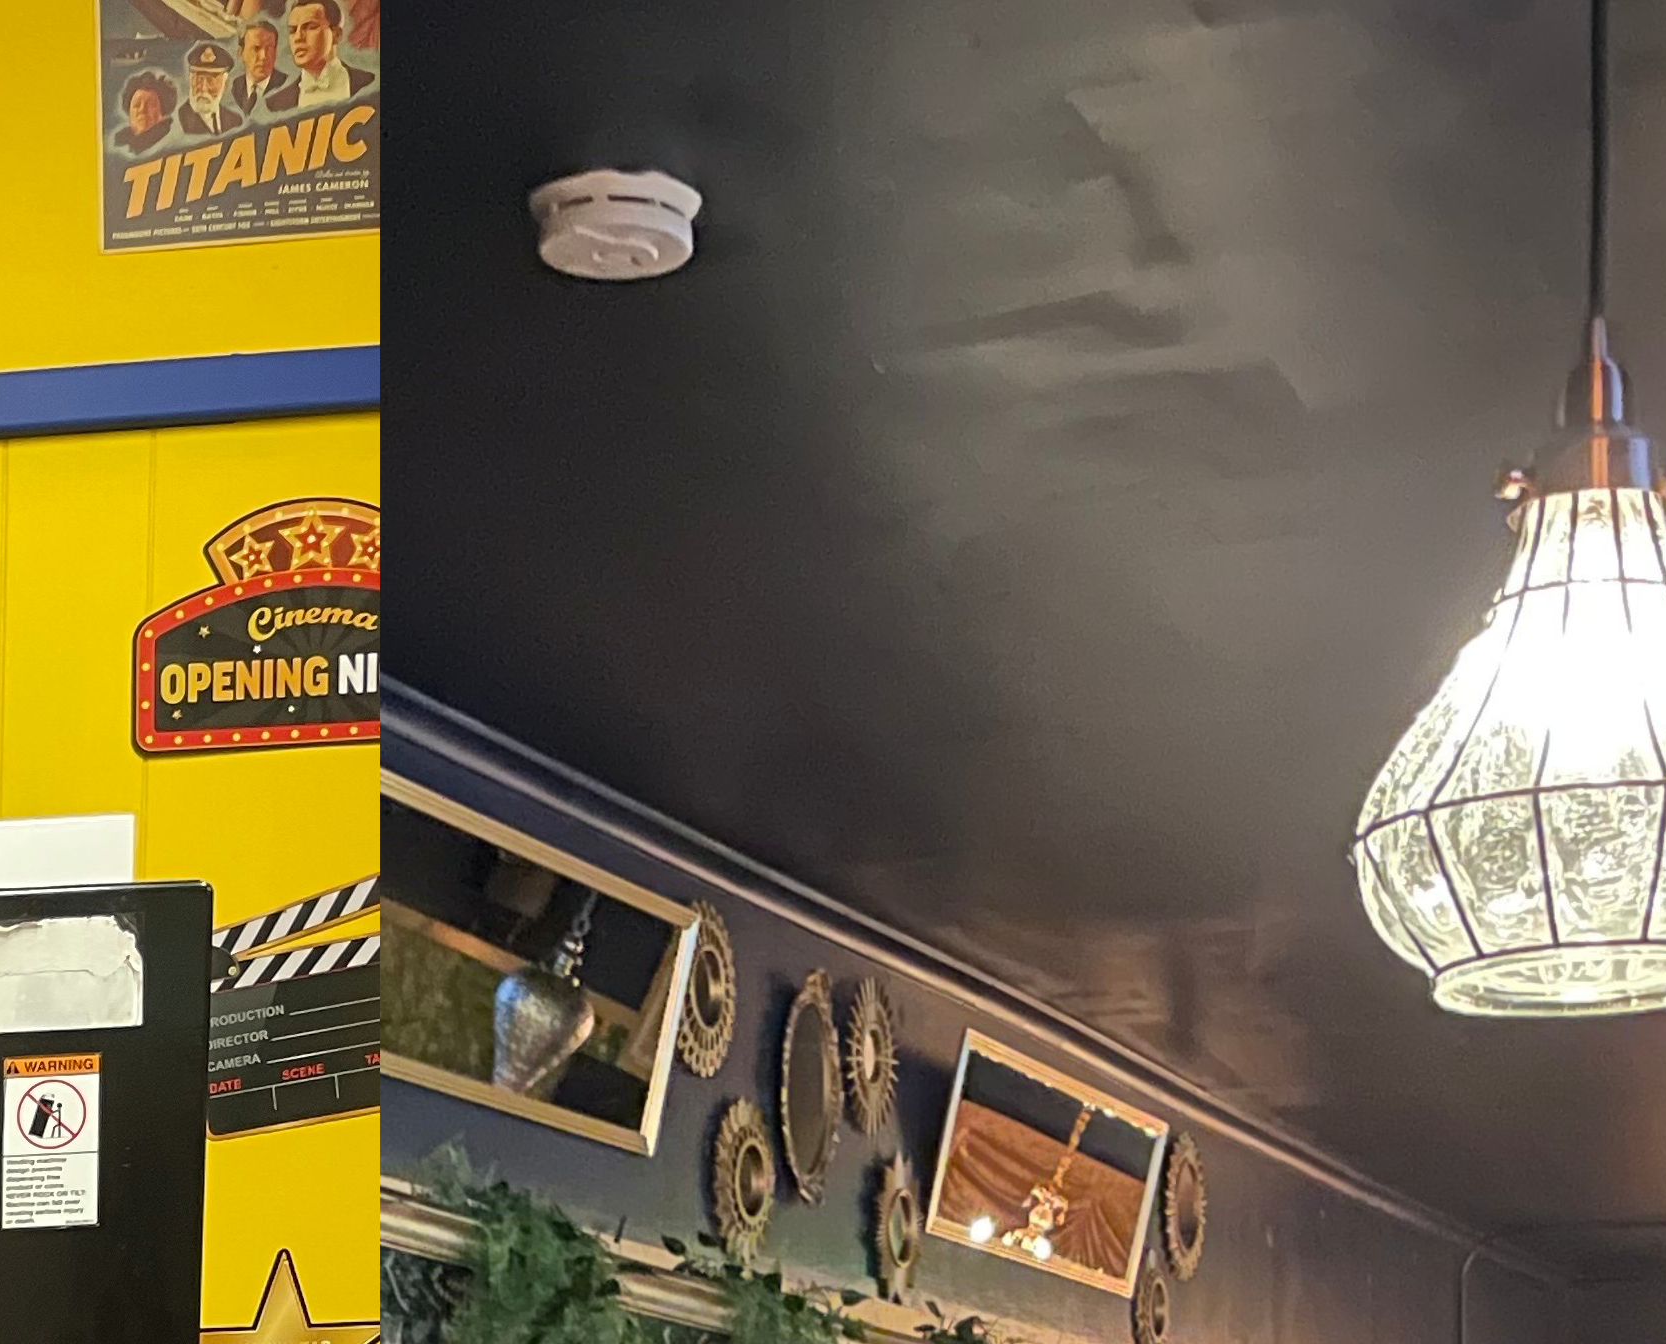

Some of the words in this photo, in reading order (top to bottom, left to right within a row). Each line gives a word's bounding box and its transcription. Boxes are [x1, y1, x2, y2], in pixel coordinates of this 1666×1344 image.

[123, 105, 376, 219] TITANIC
[278, 181, 312, 196] JAMES
[316, 178, 370, 194] CAMERON
[248, 606, 378, 641] Cinema
[160, 655, 330, 704] OPENING
[338, 652, 380, 694] NI
[209, 1004, 285, 1028] RODUCTION
[24, 1058, 94, 1073] WARNING
[208, 1053, 261, 1072] CAMERA
[209, 1078, 242, 1094] DATE
[282, 1063, 325, 1081] SCENE
